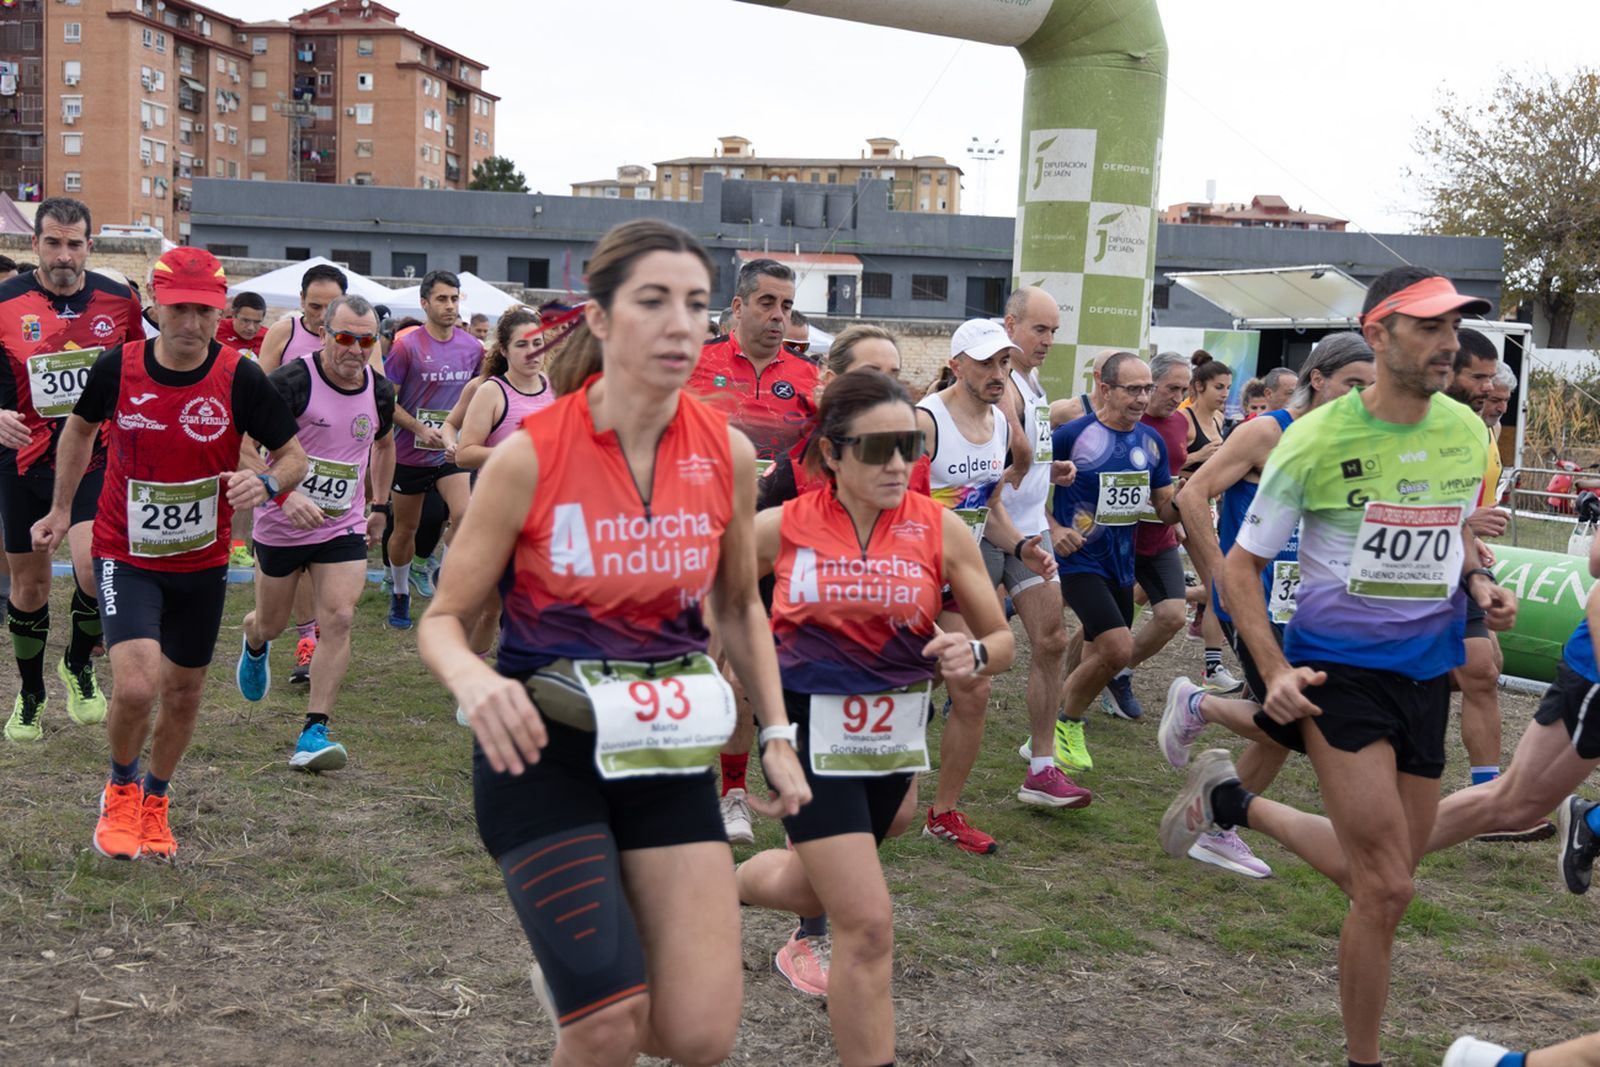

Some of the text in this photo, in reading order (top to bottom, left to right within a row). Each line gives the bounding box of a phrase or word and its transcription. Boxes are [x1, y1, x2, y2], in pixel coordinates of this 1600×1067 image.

[1045, 160, 1087, 169] DIPUTACIÓN
[1103, 163, 1150, 175] DEPORTES
[1054, 169, 1071, 177] JAÉN
[1109, 235, 1145, 246] DIPUTACIÓN
[1089, 306, 1138, 316] DEPORTES
[41, 369, 90, 394] 300
[1398, 450, 1428, 463] vive
[302, 475, 348, 499] 449
[1106, 487, 1141, 505] 356
[141, 501, 203, 530] 284
[1362, 527, 1450, 561] 4070
[1360, 569, 1444, 580] BUENO GONZALEZ
[628, 677, 691, 722] 93
[842, 695, 895, 733] 92
[831, 744, 877, 754] Gonzalez
